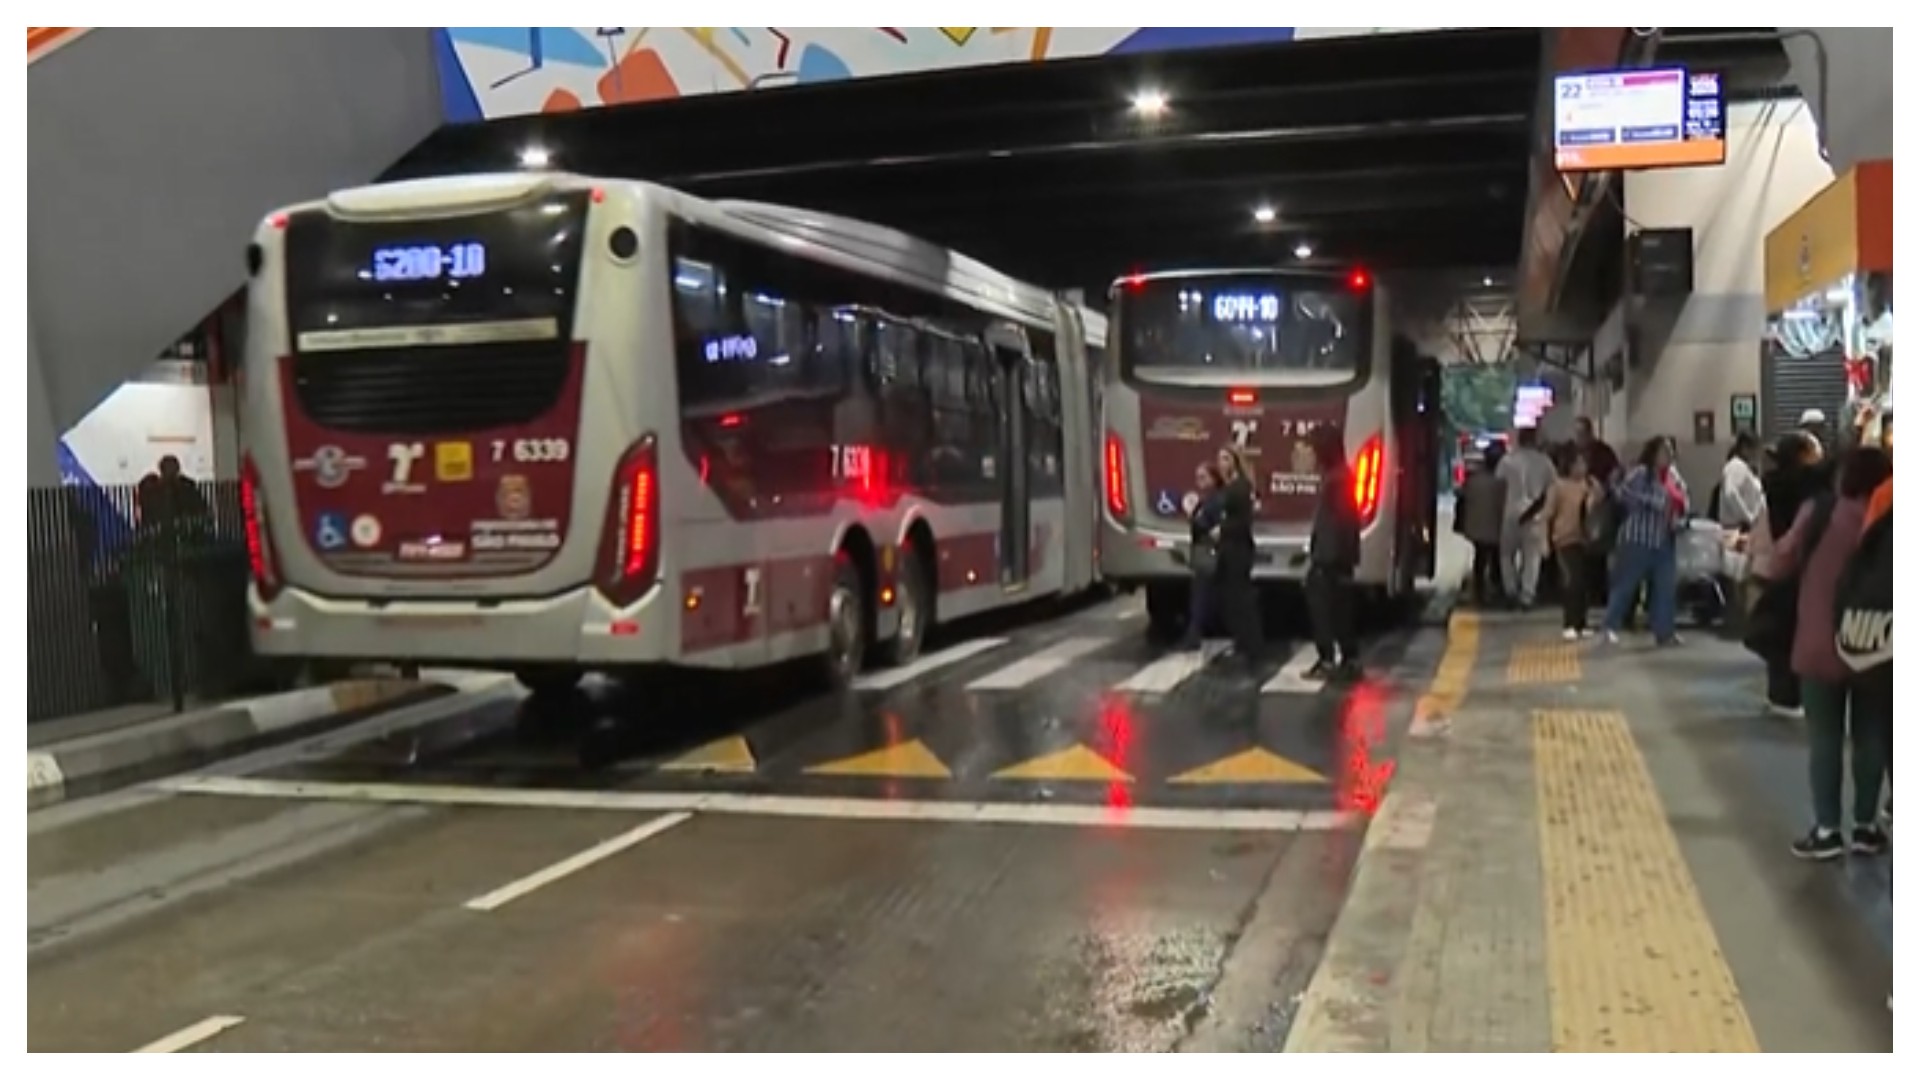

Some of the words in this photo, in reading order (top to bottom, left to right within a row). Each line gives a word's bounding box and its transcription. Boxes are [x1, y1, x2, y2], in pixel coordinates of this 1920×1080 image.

[1561, 84, 1582, 99] 22
[491, 440, 504, 461] 7
[1840, 608, 1893, 650] NIK
